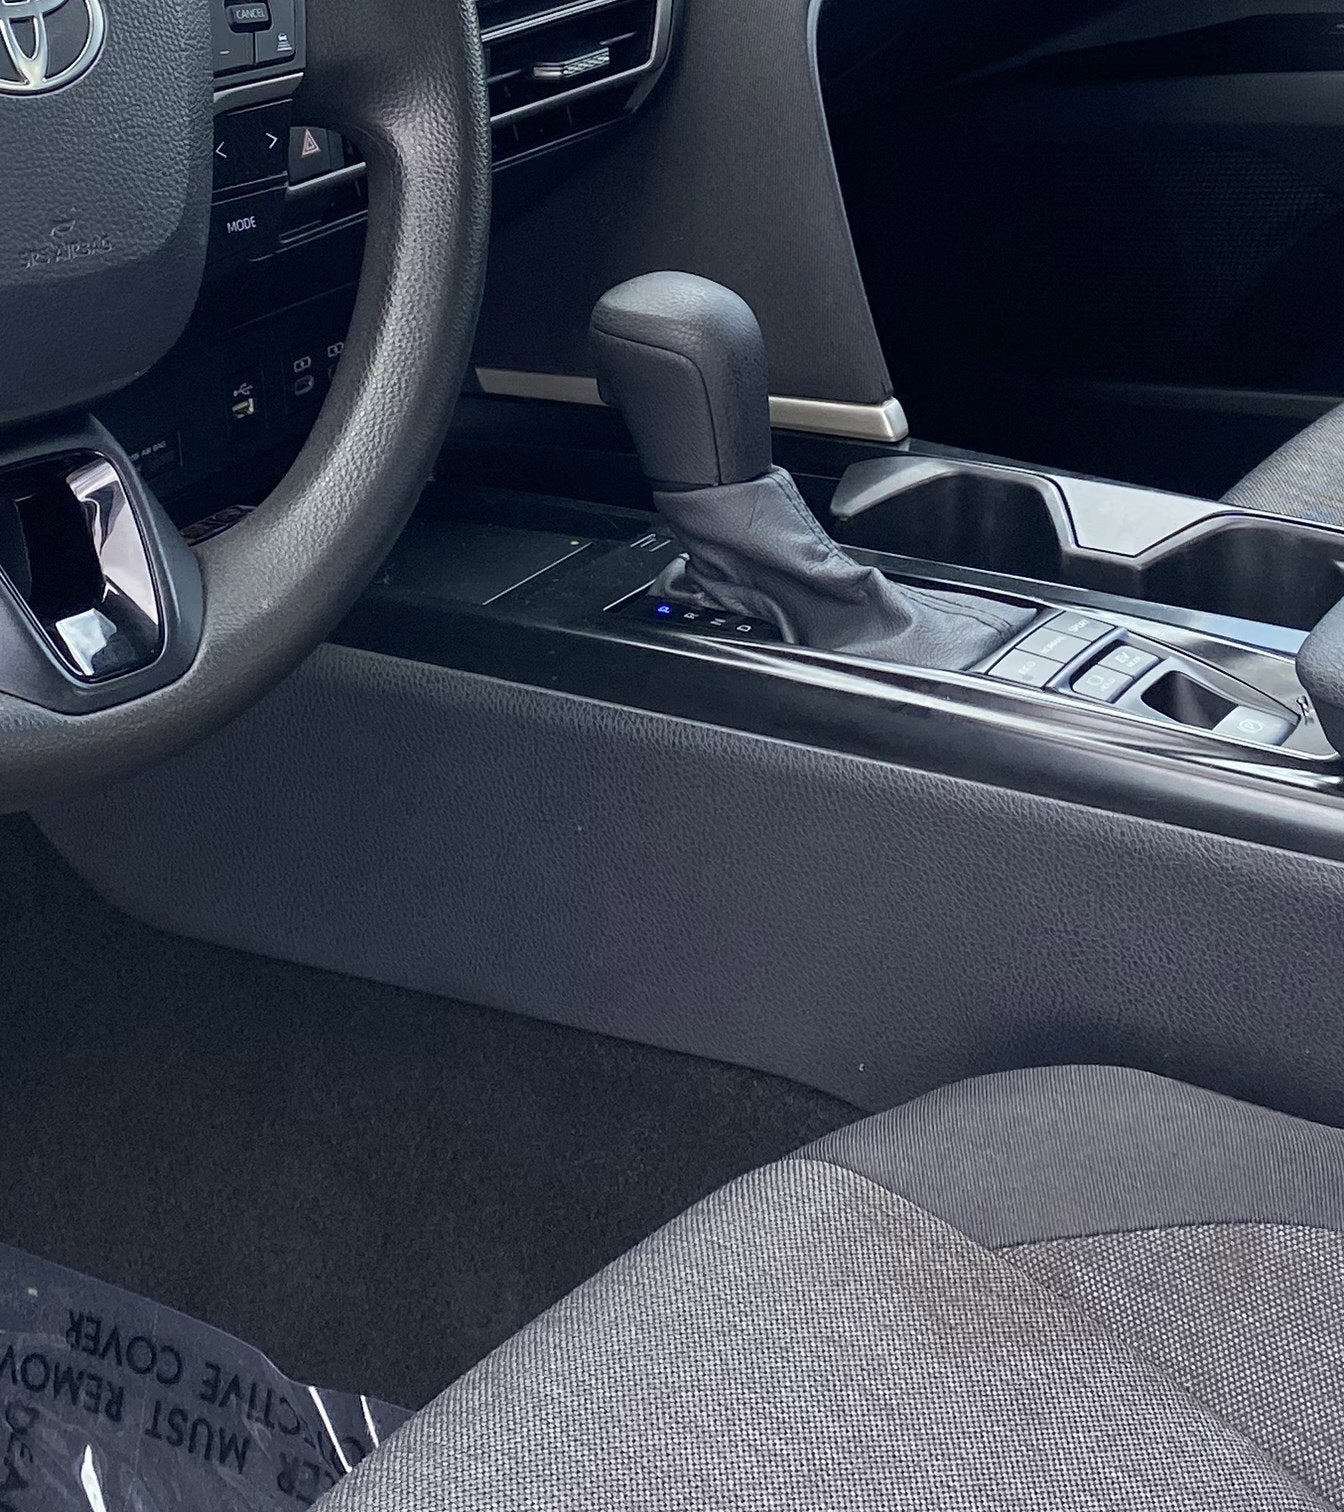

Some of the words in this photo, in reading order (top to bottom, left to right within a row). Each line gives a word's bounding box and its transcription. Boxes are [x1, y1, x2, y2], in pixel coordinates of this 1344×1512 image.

[235, 8, 266, 20] CANCEL
[226, 215, 257, 234] MODE
[66, 1309, 184, 1387] COVER
[143, 1398, 251, 1474] MUST
